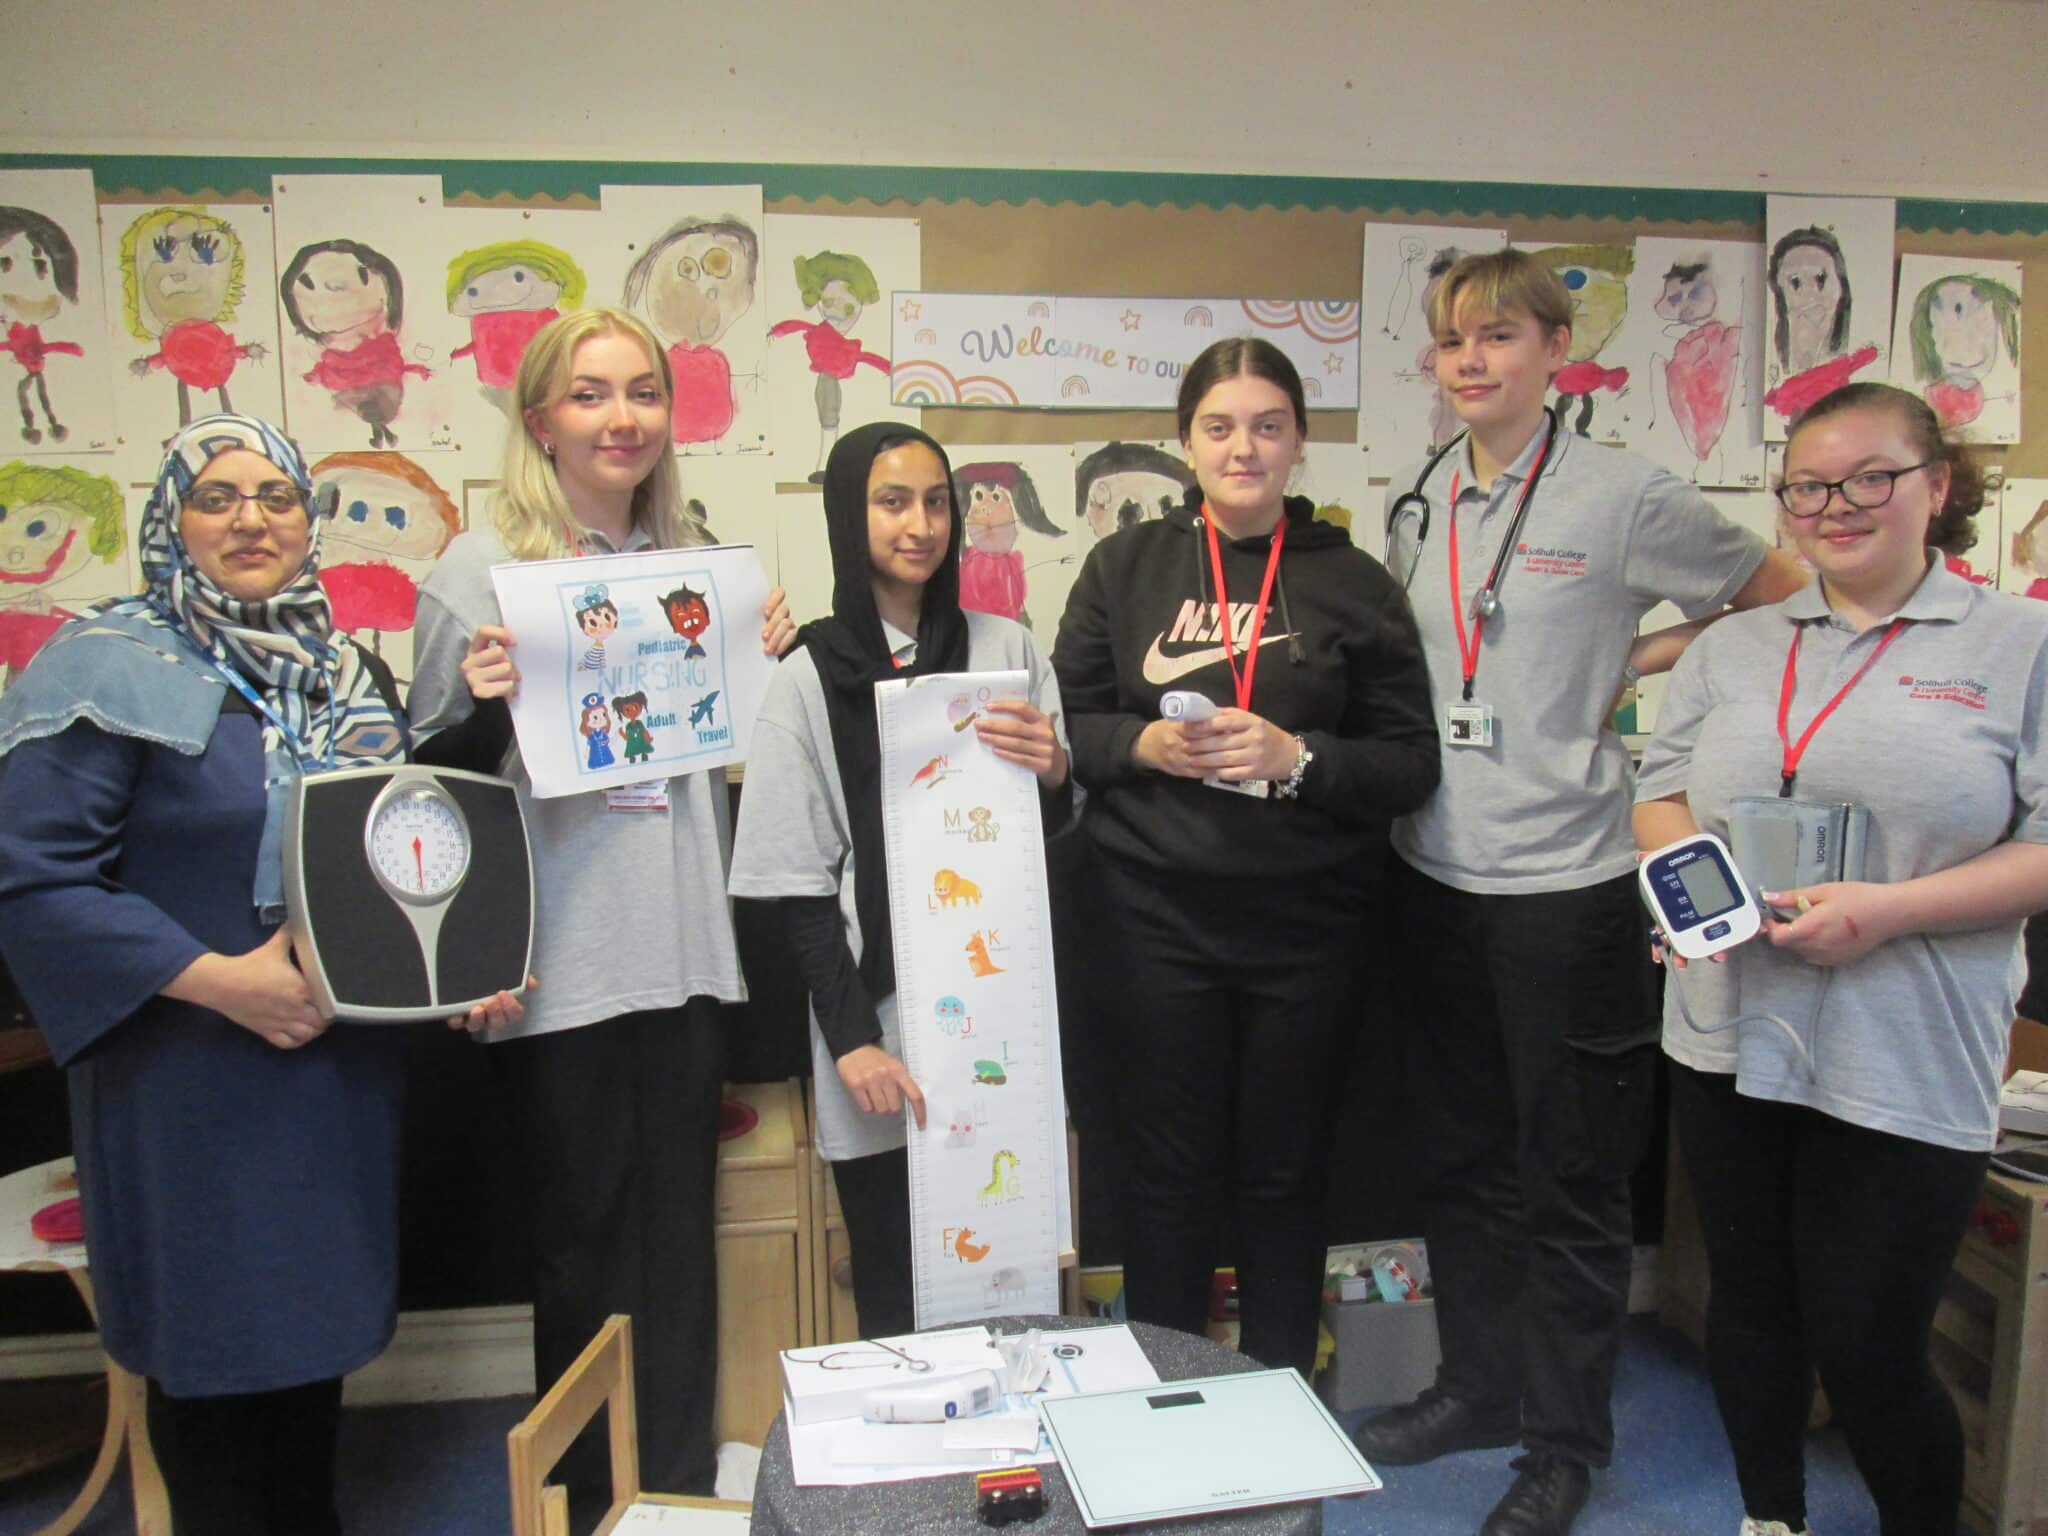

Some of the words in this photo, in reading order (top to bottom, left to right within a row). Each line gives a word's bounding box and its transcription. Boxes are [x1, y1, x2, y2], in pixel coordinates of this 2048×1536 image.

[960, 323, 1119, 368] Welcome
[637, 638, 687, 657] Pediatric
[646, 712, 677, 730] Adult
[696, 725, 729, 745] Travel
[944, 807, 961, 828] M
[988, 928, 1000, 945] K
[960, 1016, 973, 1034] J
